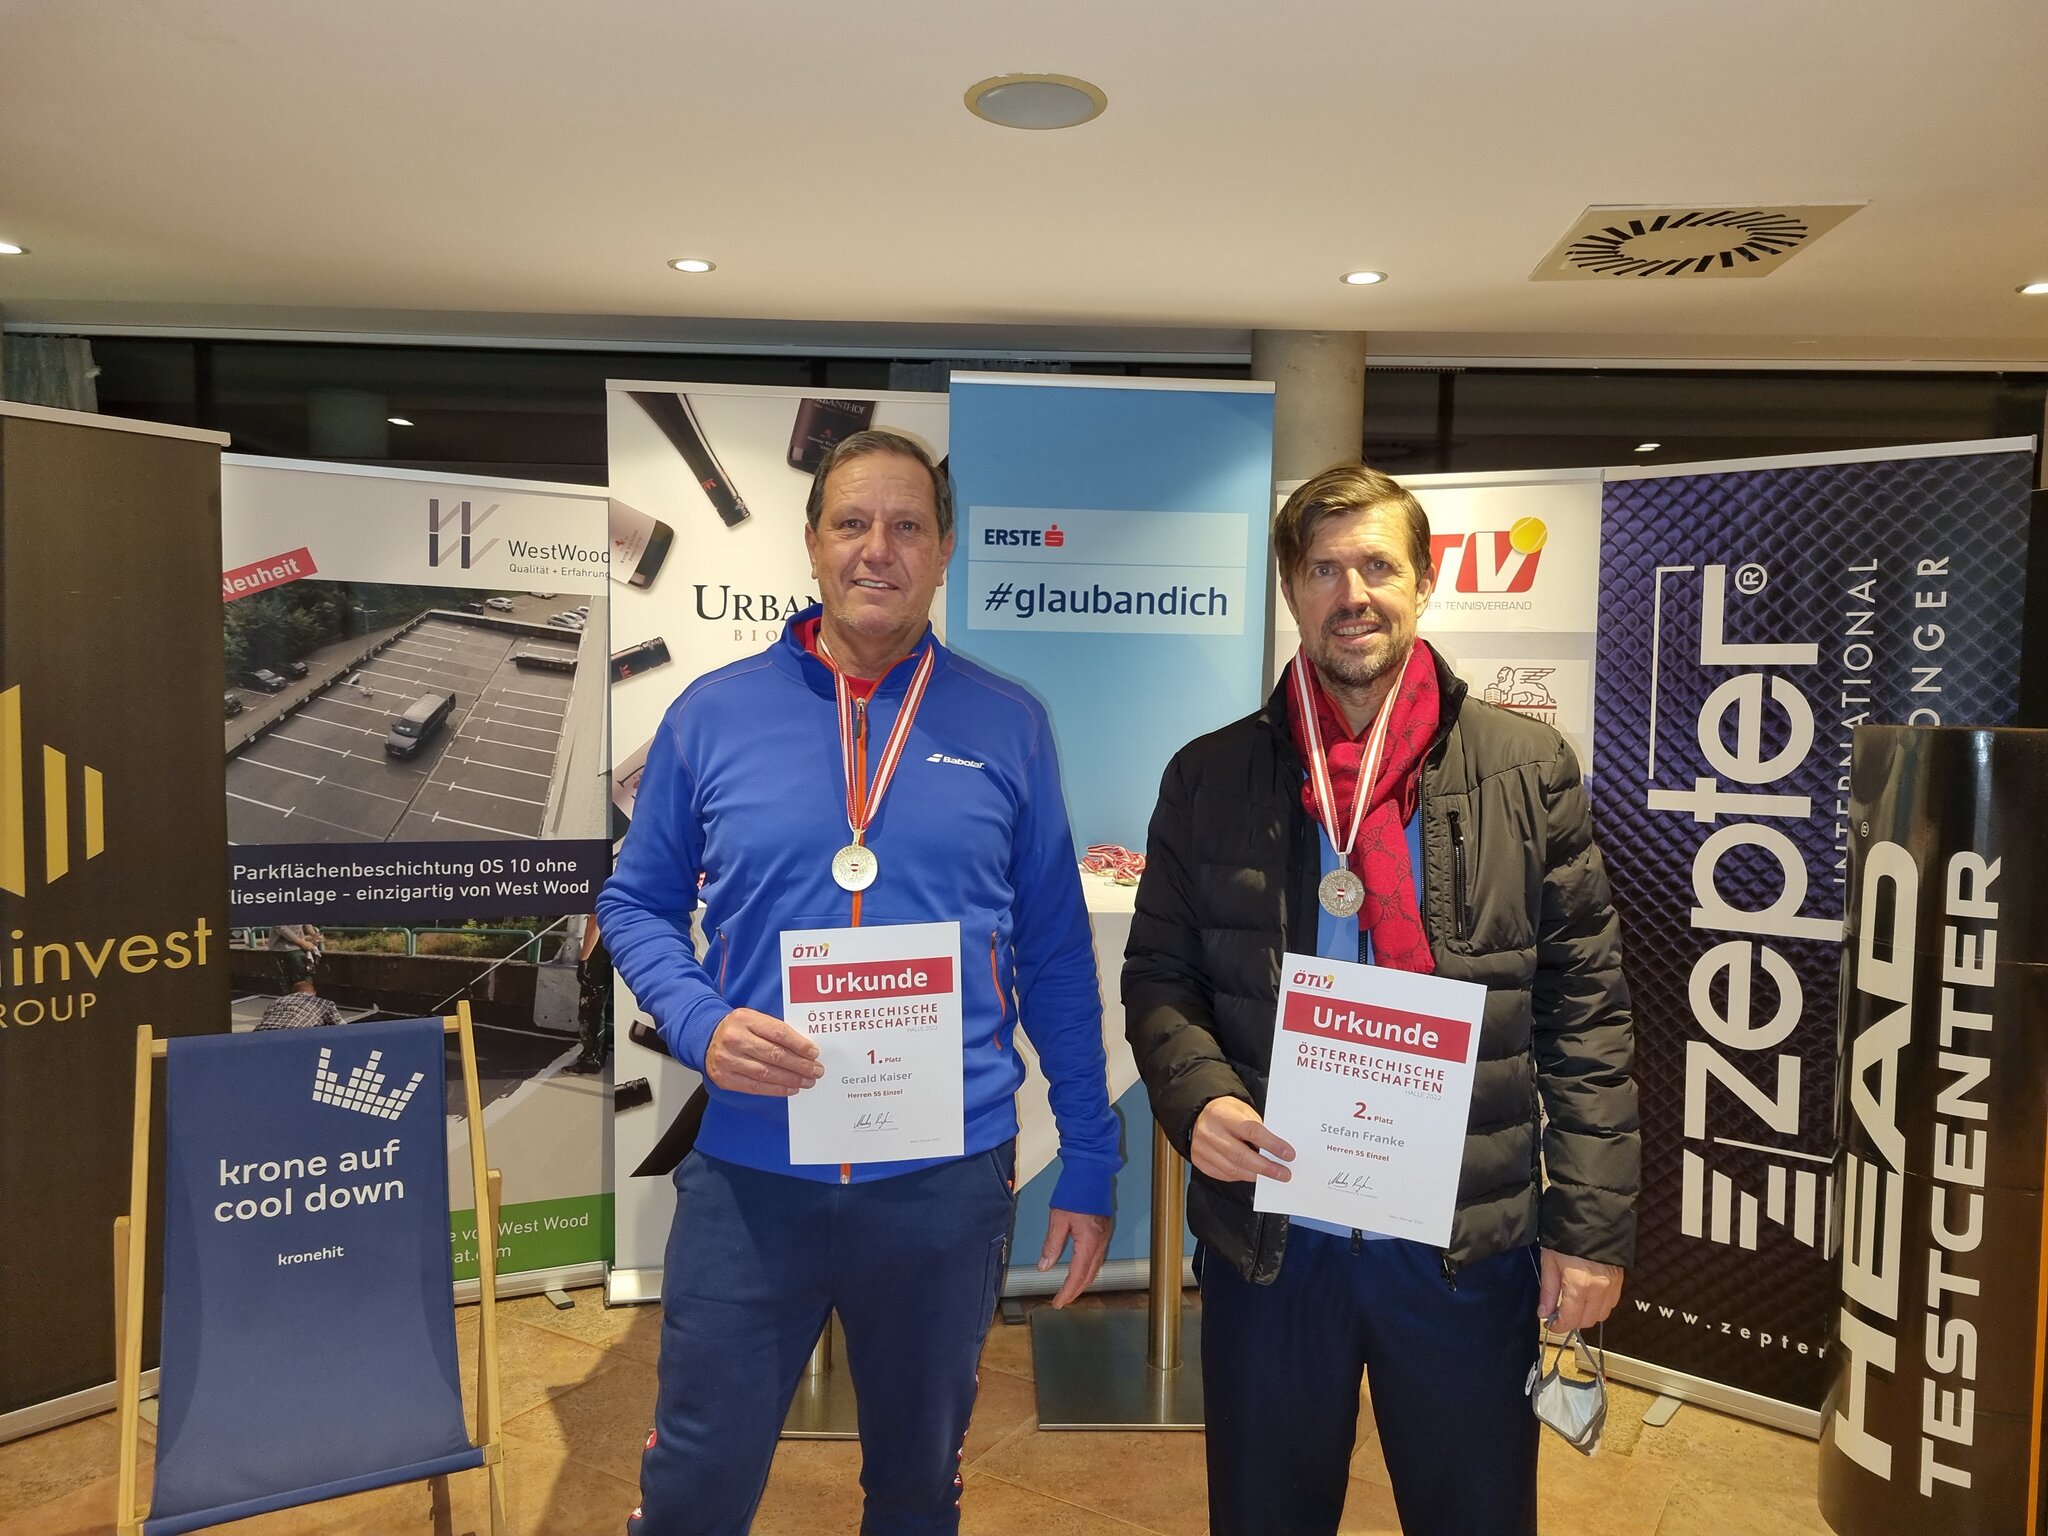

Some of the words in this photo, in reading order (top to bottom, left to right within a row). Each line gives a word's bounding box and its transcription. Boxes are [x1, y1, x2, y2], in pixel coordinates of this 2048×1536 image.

[984, 528, 1041, 546] ERSTE
[509, 564, 549, 575] Qualität
[984, 582, 1227, 619] #glaubandich
[1444, 601, 1533, 611] TENNISVERBAND
[734, 629, 778, 641] BIO
[233, 860, 474, 881] Parkflächenbeschichtung
[479, 859, 504, 874] OS
[510, 858, 531, 873] 10
[535, 858, 577, 873] ohne
[228, 887, 337, 905] lieseinlage
[356, 883, 454, 902] einzigartig
[459, 885, 491, 897] von
[496, 881, 539, 896] West
[543, 879, 590, 895] Wood
[816, 967, 928, 994] Urkunde
[808, 1003, 938, 1022] ÖSTERREICHISCHE
[808, 1014, 938, 1034] MEISTERSCHAFTEN
[1313, 1005, 1439, 1049] Urkunde
[867, 1049, 883, 1064] 1.
[1298, 1041, 1445, 1081] ÖSTERREICHISCHE
[841, 1074, 877, 1085] Gerald
[880, 1072, 913, 1082] Kaiser
[1296, 1056, 1443, 1094] MEISTERSCHAFTEN
[847, 1091, 872, 1099] Herren
[883, 1088, 903, 1097] Einzel
[1353, 1101, 1372, 1121] 2.
[1374, 1115, 1394, 1125] Platz
[1320, 1123, 1359, 1139] Stefan
[1362, 1131, 1405, 1147] Franke
[220, 1155, 327, 1186] krone
[339, 1138, 401, 1173] auf
[1326, 1144, 1354, 1155] Herren
[1366, 1151, 1389, 1162] Einzel
[1834, 840, 1919, 1482] HEAD
[1919, 851, 2002, 1498] TESTCENTER
[214, 1187, 292, 1223] cool
[304, 1179, 404, 1213] down
[498, 1219, 539, 1237] West
[543, 1212, 589, 1231] Wood
[278, 1246, 345, 1266] kronehit
